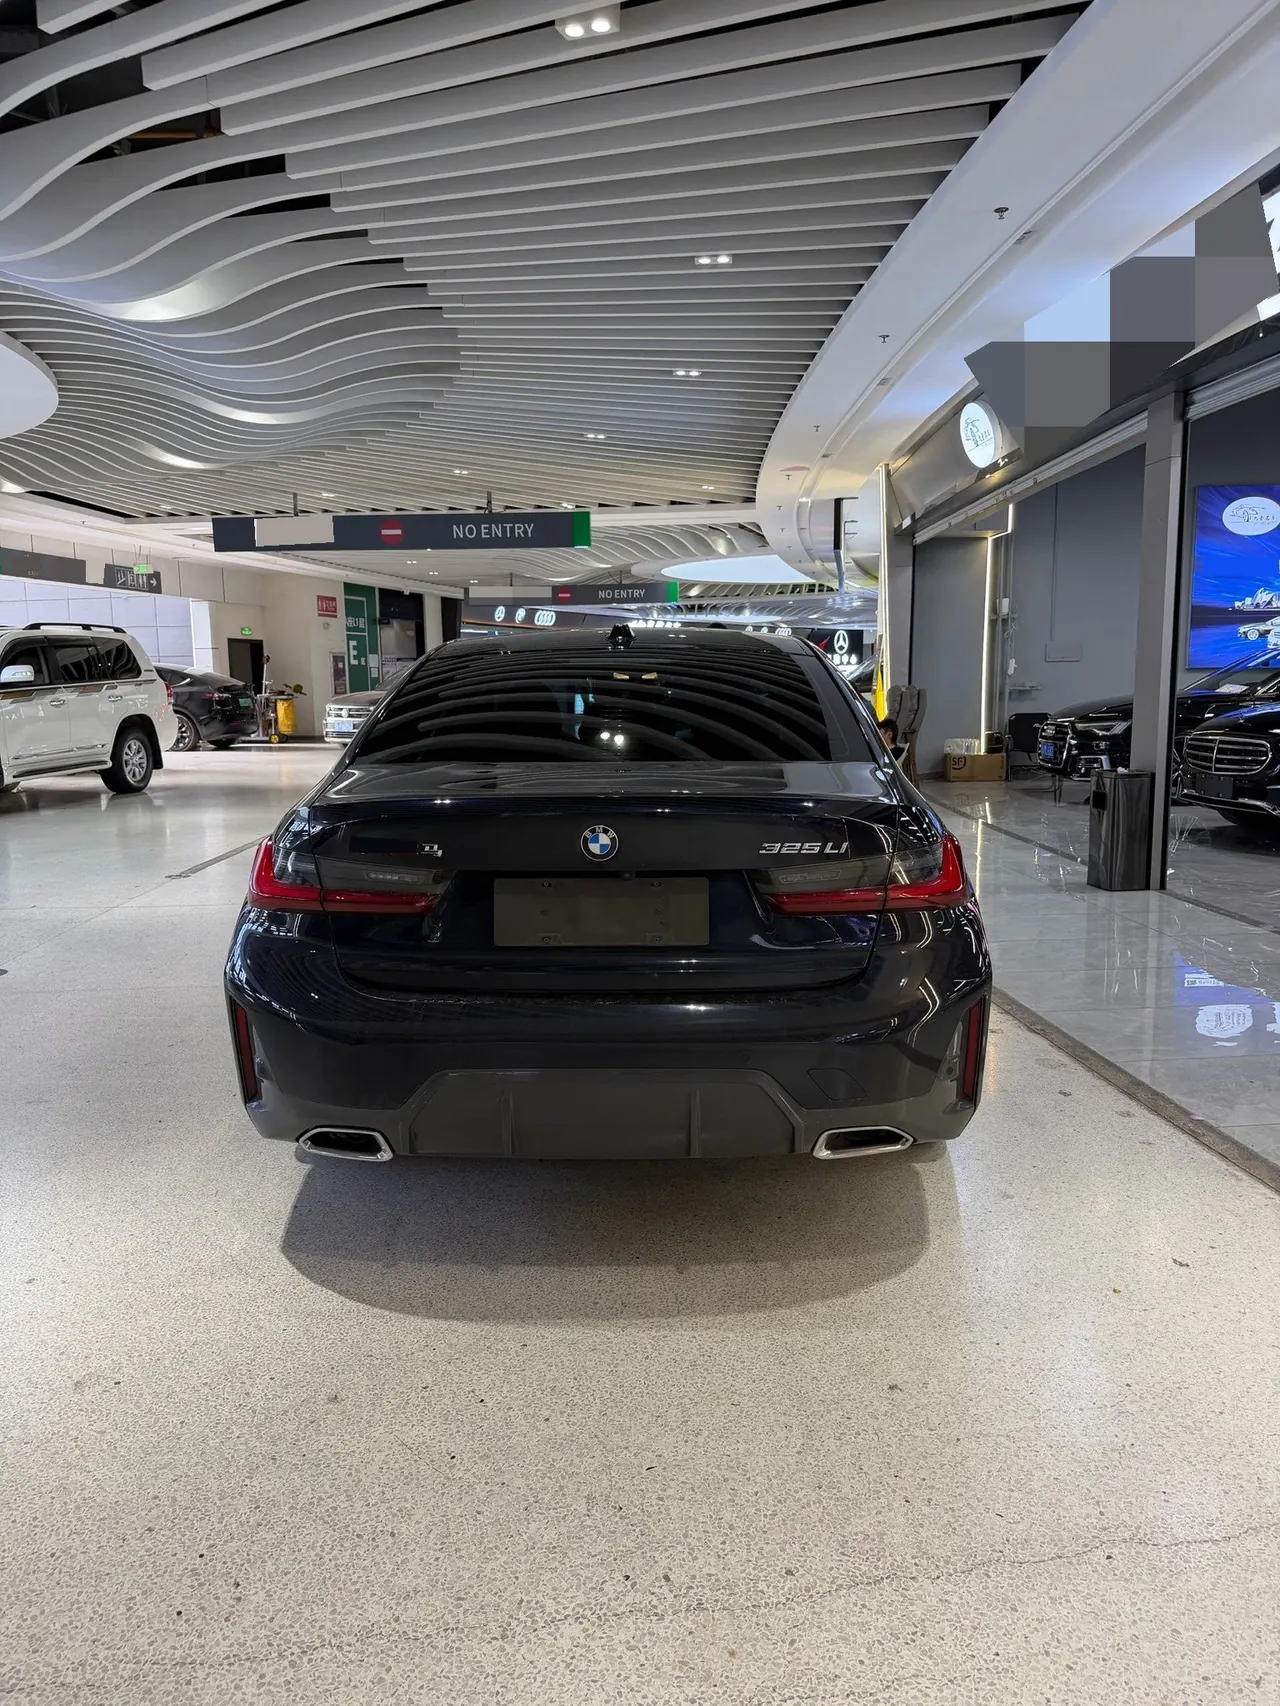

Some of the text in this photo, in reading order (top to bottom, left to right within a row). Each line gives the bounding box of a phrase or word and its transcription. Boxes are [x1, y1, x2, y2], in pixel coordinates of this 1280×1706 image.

[452, 523, 534, 539] NO ENTRY
[598, 589, 646, 599] NO ENTRY
[952, 757, 964, 766] SF
